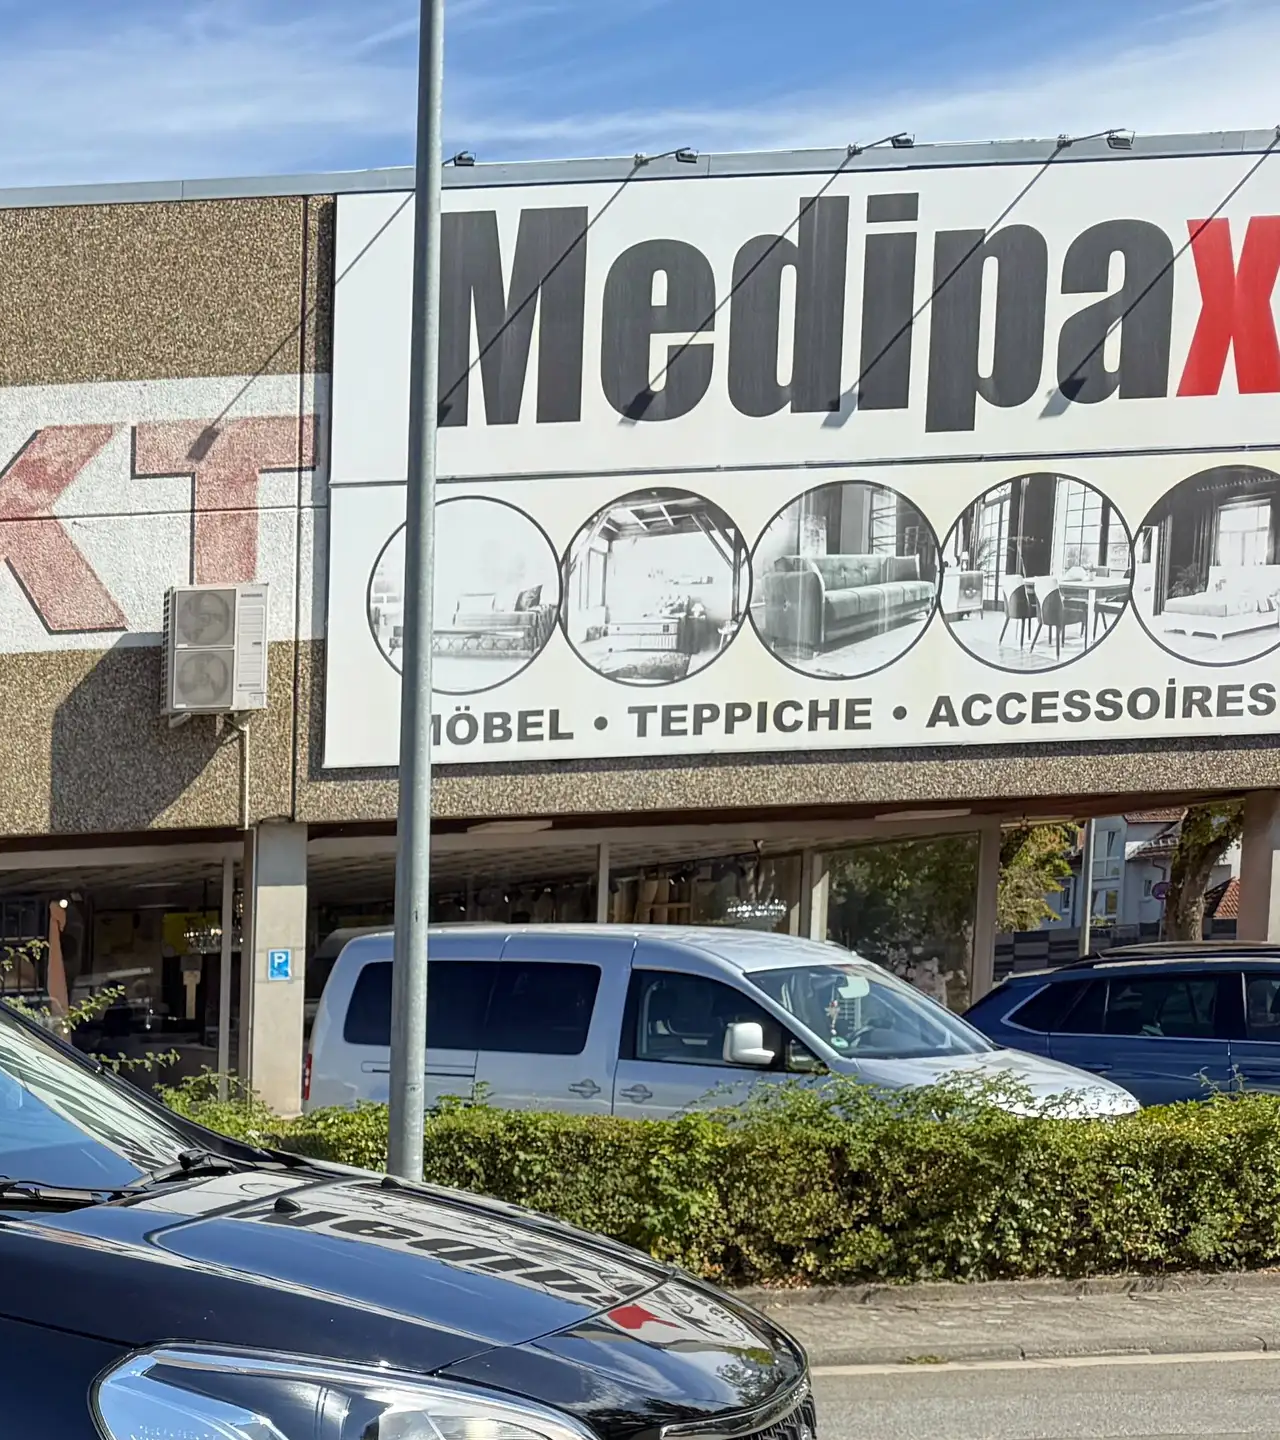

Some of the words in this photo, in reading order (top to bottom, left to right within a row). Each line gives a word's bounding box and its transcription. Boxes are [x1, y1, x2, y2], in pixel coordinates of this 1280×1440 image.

[437, 192, 1280, 434] Medipax
[627, 696, 873, 740] TEPPICHE
[274, 952, 287, 969] P
